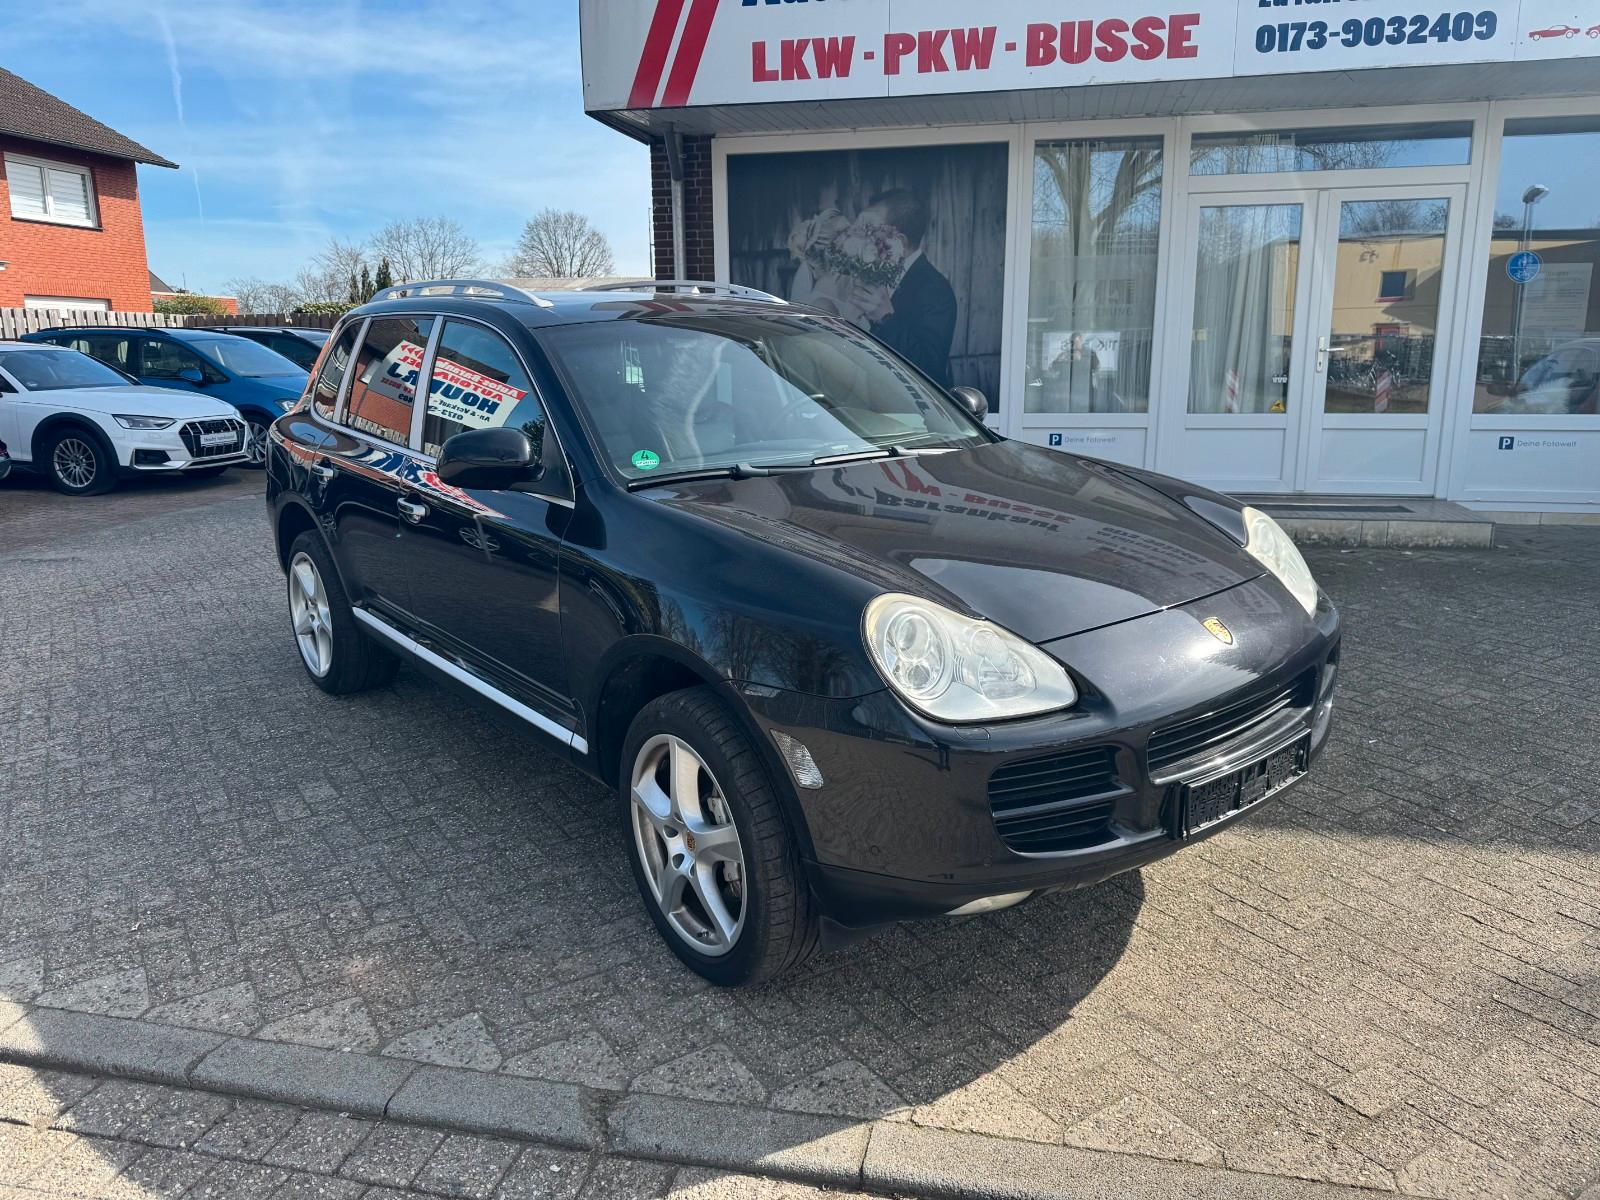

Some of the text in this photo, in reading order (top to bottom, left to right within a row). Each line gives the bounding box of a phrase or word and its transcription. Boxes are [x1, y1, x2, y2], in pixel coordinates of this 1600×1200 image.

[752, 36, 856, 82] LKW
[884, 27, 997, 75] PKW
[1026, 13, 1200, 67] BUSSE
[1255, 11, 1497, 53] 0173-9032409
[641, 450, 650, 460] 4
